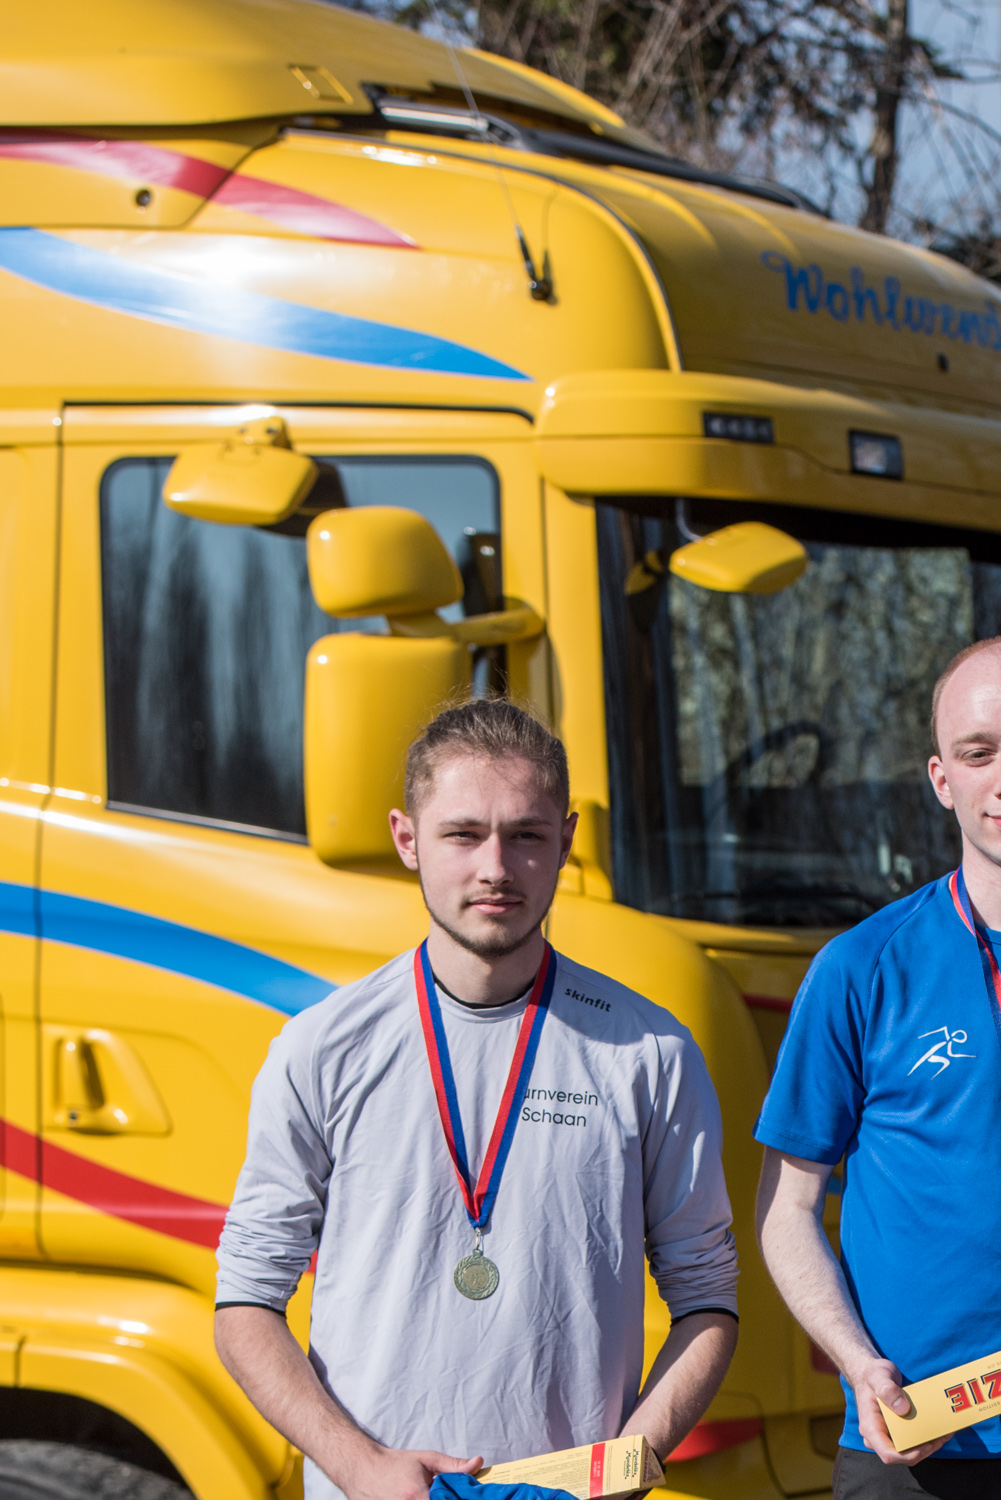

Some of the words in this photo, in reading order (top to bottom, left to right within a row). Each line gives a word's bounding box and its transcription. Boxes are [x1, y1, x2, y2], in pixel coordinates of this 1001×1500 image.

[565, 987, 612, 1012] skinfit
[524, 1088, 598, 1106] urnverein
[521, 1107, 587, 1127] Schaan
